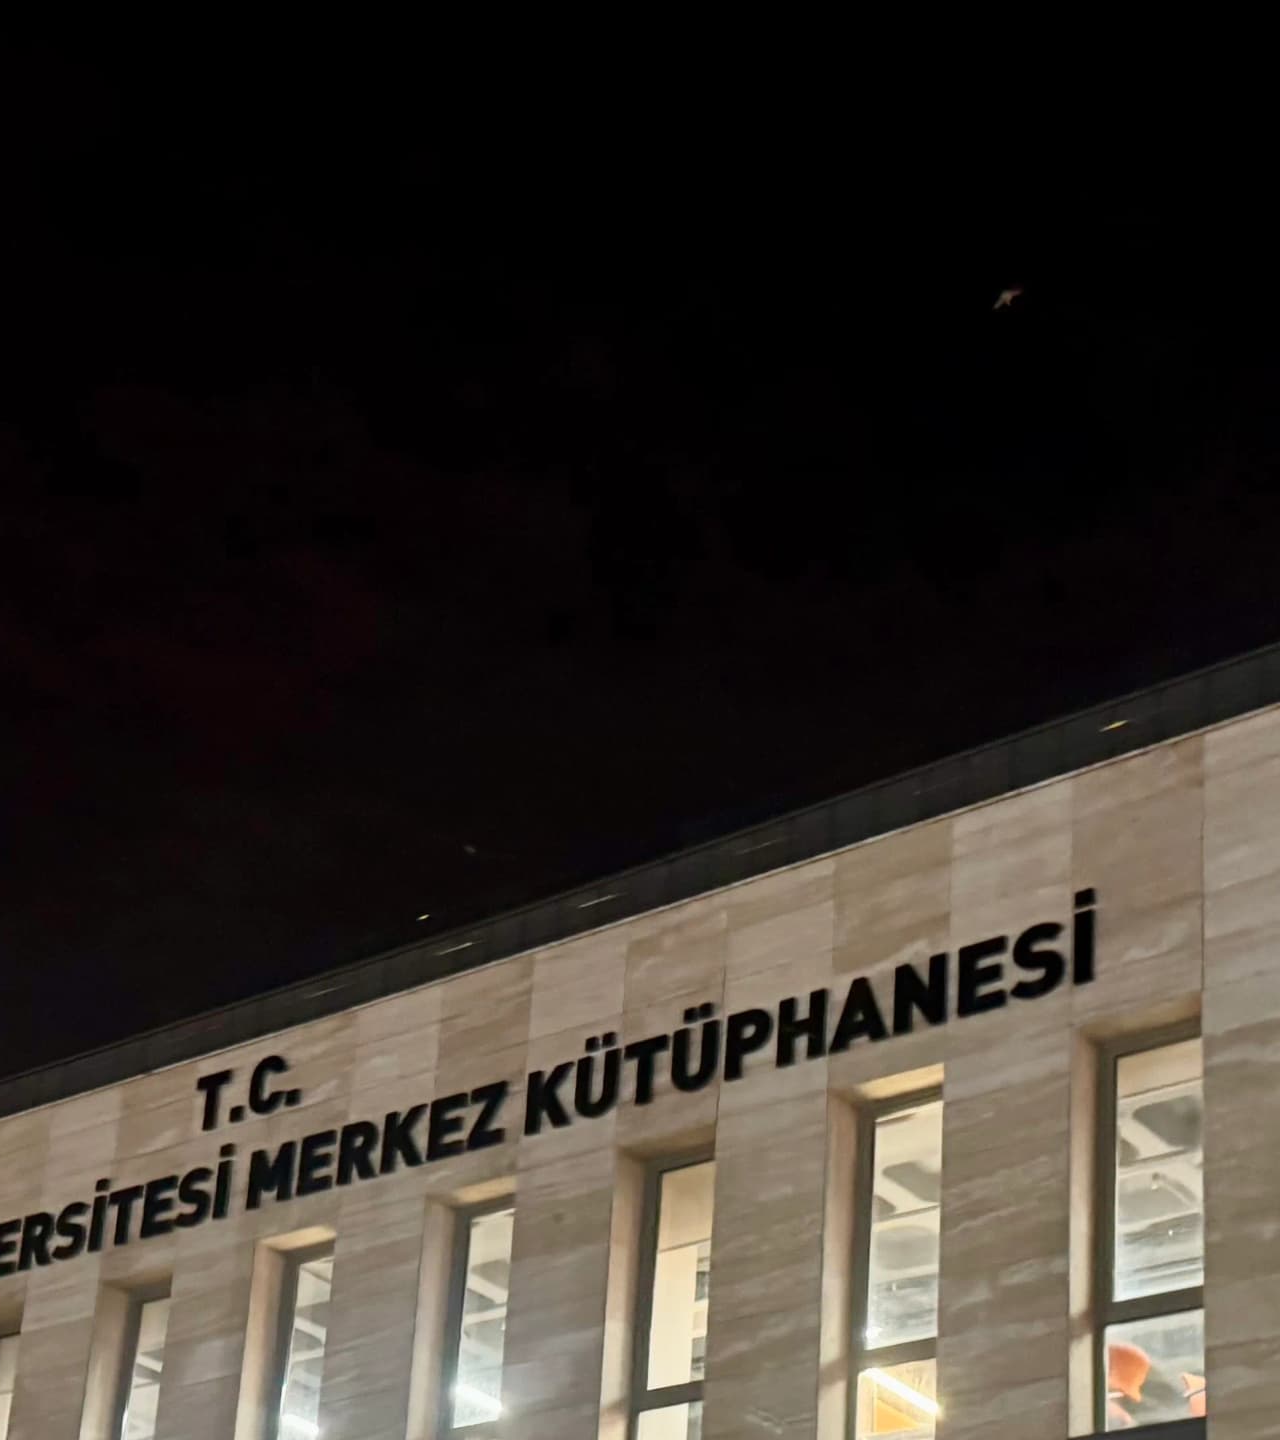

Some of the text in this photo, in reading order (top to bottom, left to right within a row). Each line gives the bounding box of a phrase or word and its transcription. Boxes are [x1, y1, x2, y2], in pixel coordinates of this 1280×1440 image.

[197, 1055, 301, 1131] T.C.
[246, 1081, 508, 1210] MERKEZ
[523, 887, 1097, 1136] KÜTÜPHANESİ
